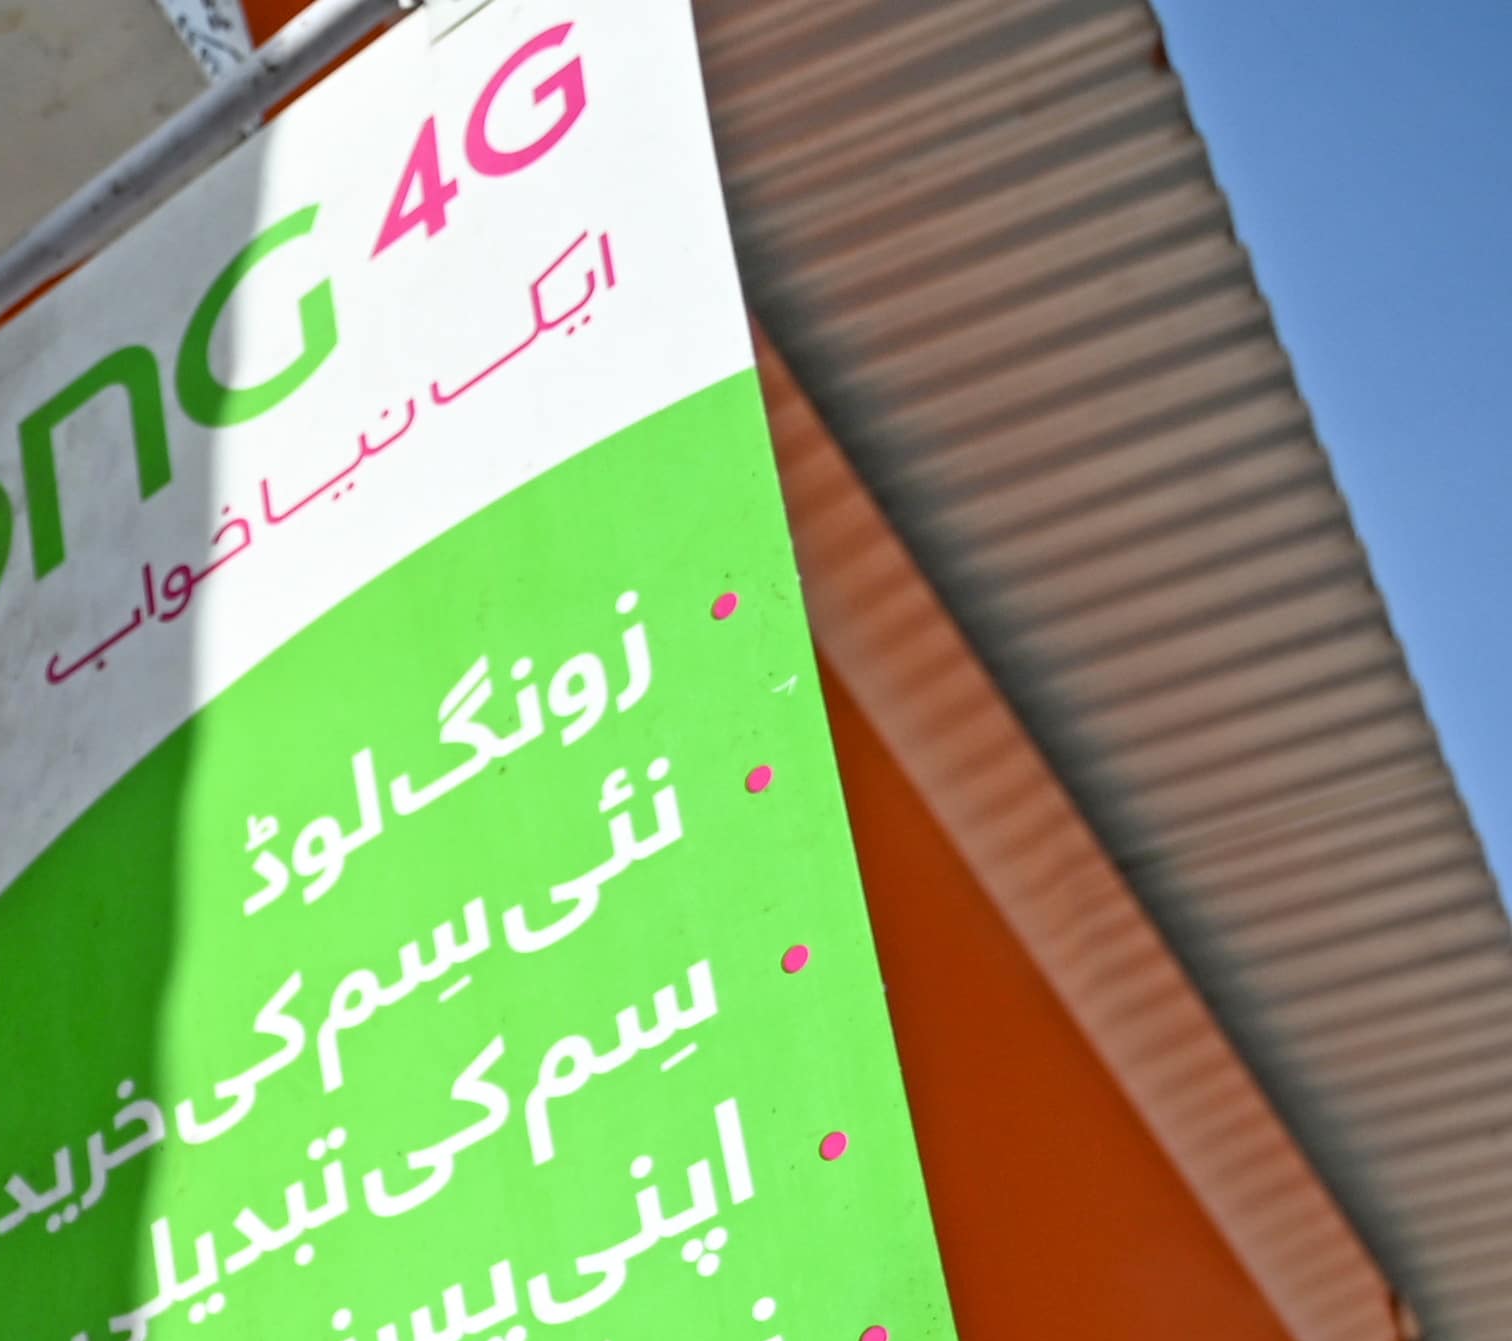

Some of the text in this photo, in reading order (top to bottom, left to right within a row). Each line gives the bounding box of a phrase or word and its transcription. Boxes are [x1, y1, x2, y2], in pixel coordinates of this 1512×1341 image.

[368, 18, 589, 261] 4G
[429, 231, 617, 406] ایک
[45, 504, 252, 685] خواب
[243, 590, 654, 917] زونگ لوڈ
[502, 757, 684, 954] نئی
[174, 971, 307, 1145] کی
[362, 1036, 512, 1218] کی
[526, 1098, 756, 1326] اپنی
